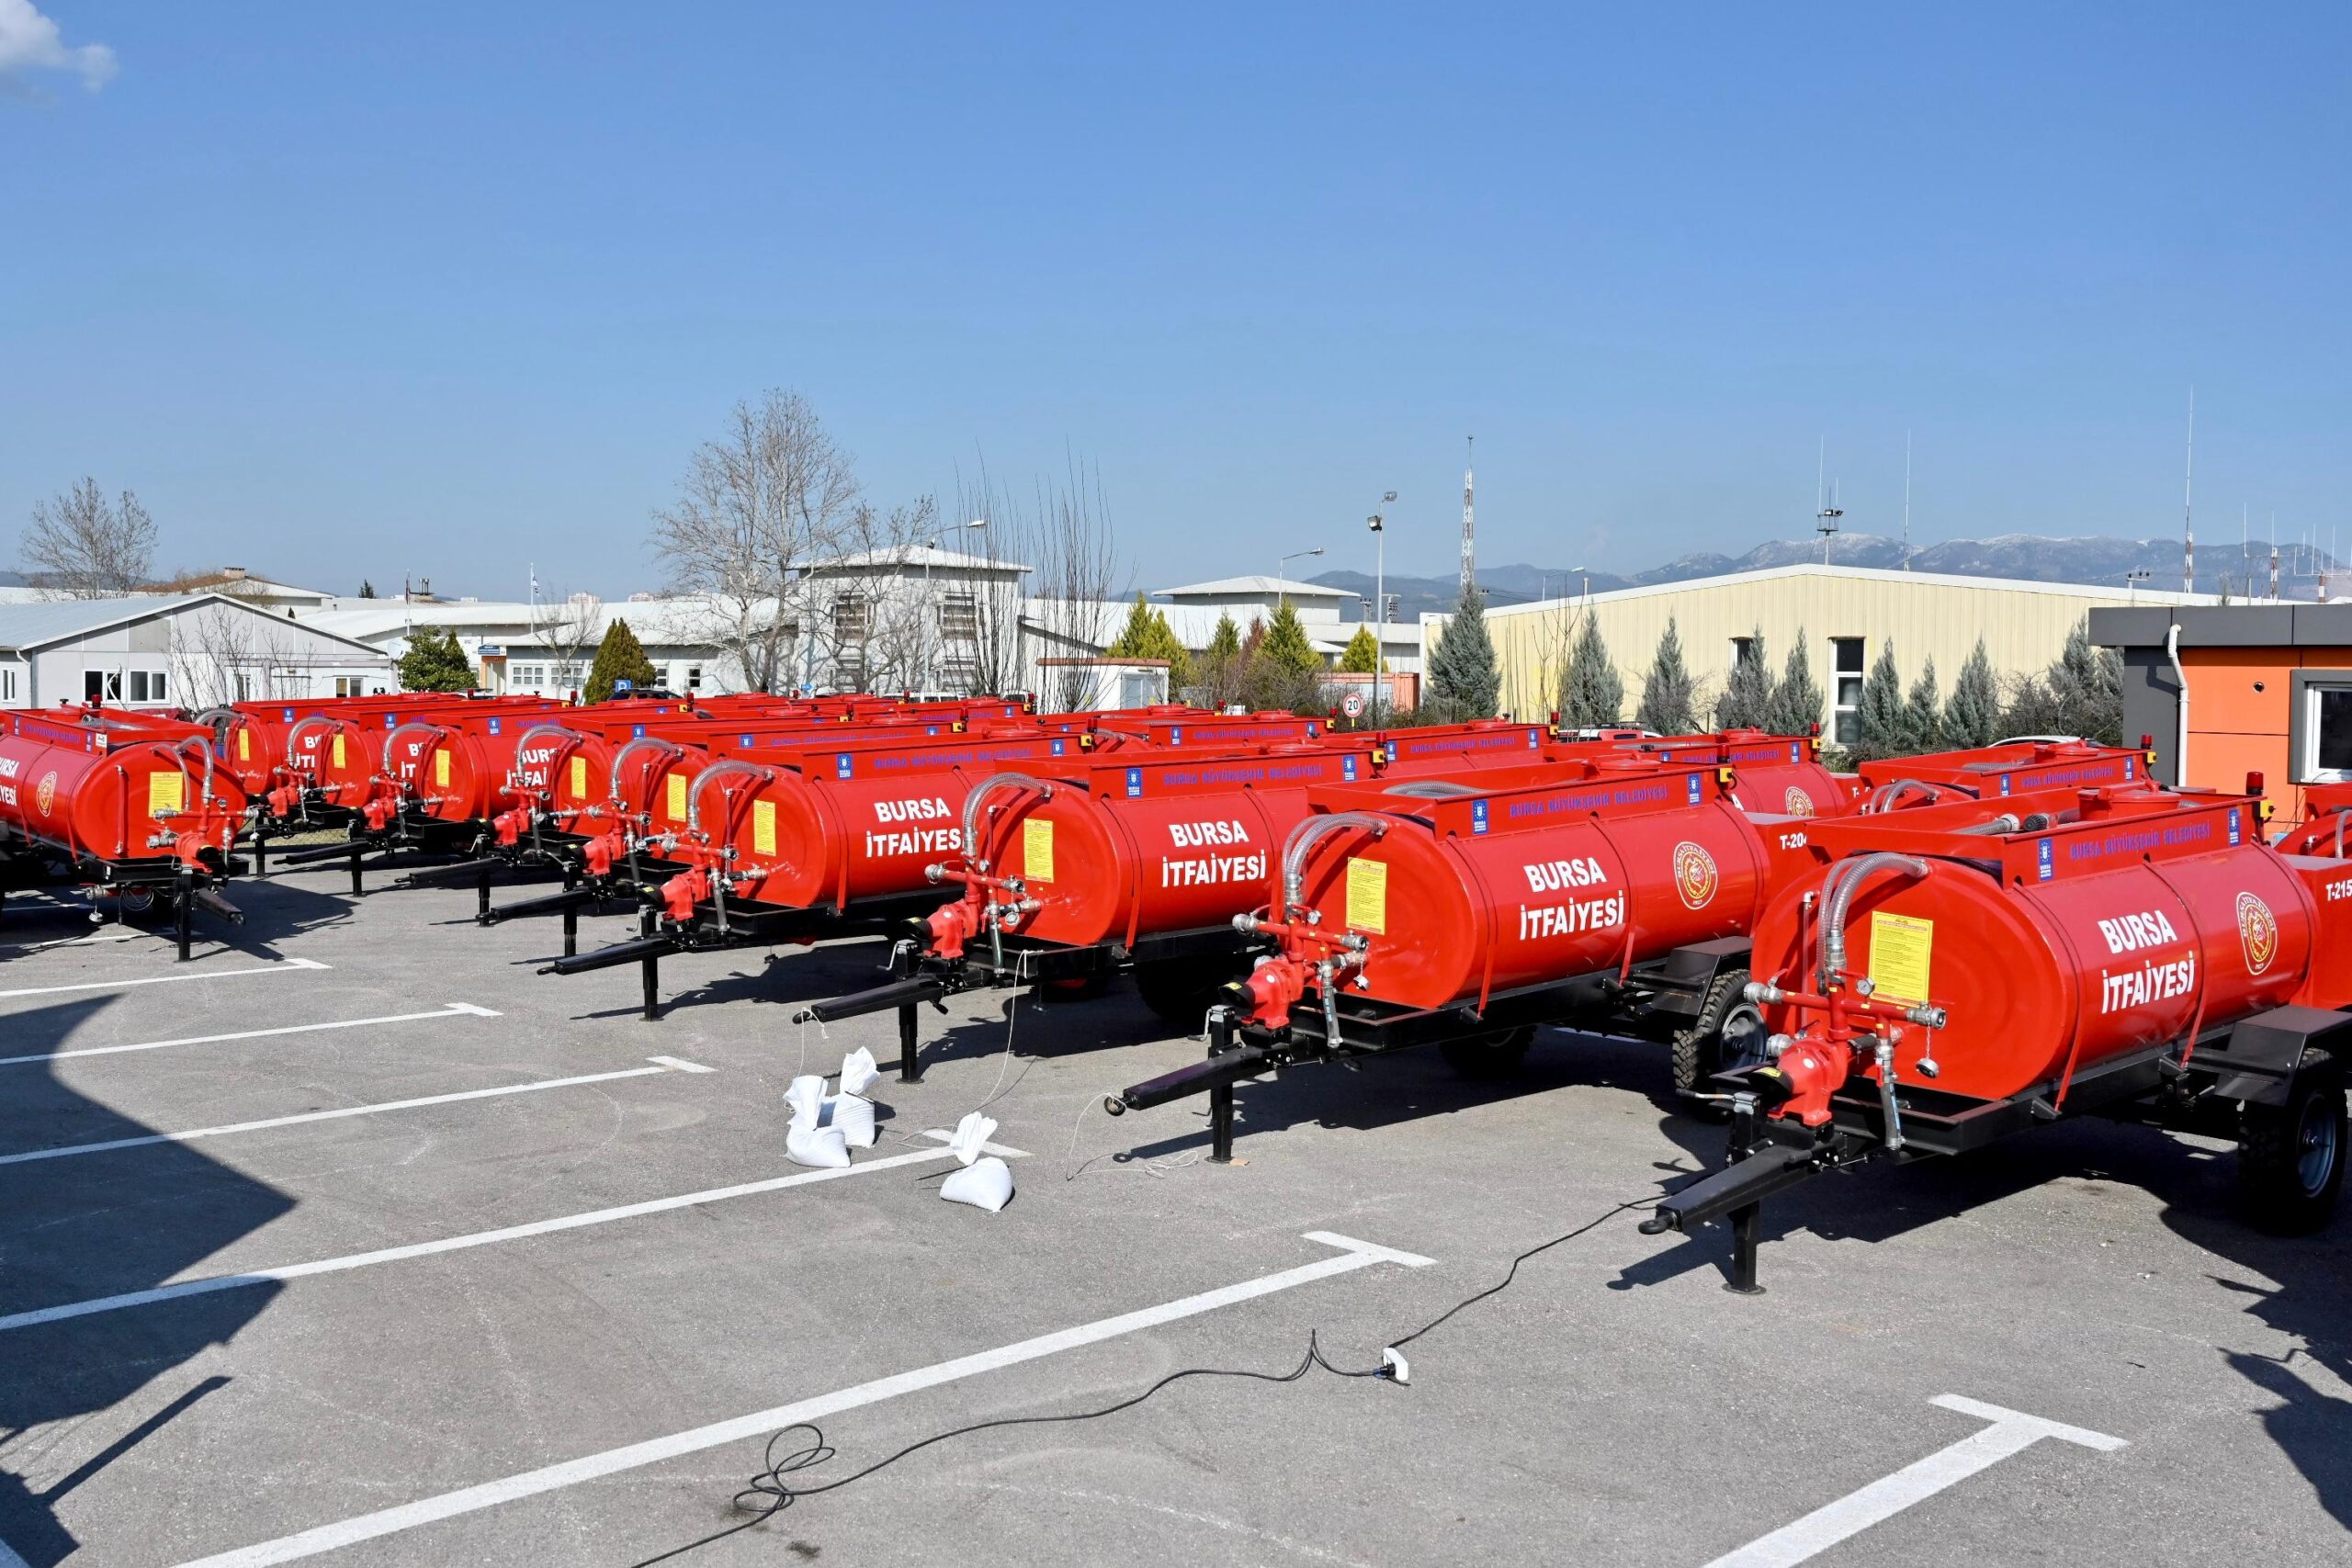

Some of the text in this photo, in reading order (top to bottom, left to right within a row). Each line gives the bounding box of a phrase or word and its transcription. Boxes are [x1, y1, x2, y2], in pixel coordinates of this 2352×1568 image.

[618, 682, 627, 691] P
[1347, 700, 1359, 711] 20
[0, 756, 19, 778] URSA
[1163, 772, 1197, 786] BURSA
[874, 797, 952, 823] BURSA
[1510, 784, 1668, 818] BURSA BÜYÜKŞEHİR BELEDİYESİ
[866, 826, 964, 858] İTFAİYES
[1169, 820, 1250, 848] BURSA
[2070, 820, 2211, 861] BURSA BÜYÜKŞEHİR BELEDİYESİ
[1162, 849, 1266, 888] İTFAİYESİ
[1523, 857, 1607, 893] BURSA
[2325, 878, 2352, 902] T-215
[1520, 889, 1624, 941] İTFAİYESİ
[2097, 909, 2178, 954] BURSA
[2101, 950, 2195, 1014] İTFAİYESİ
